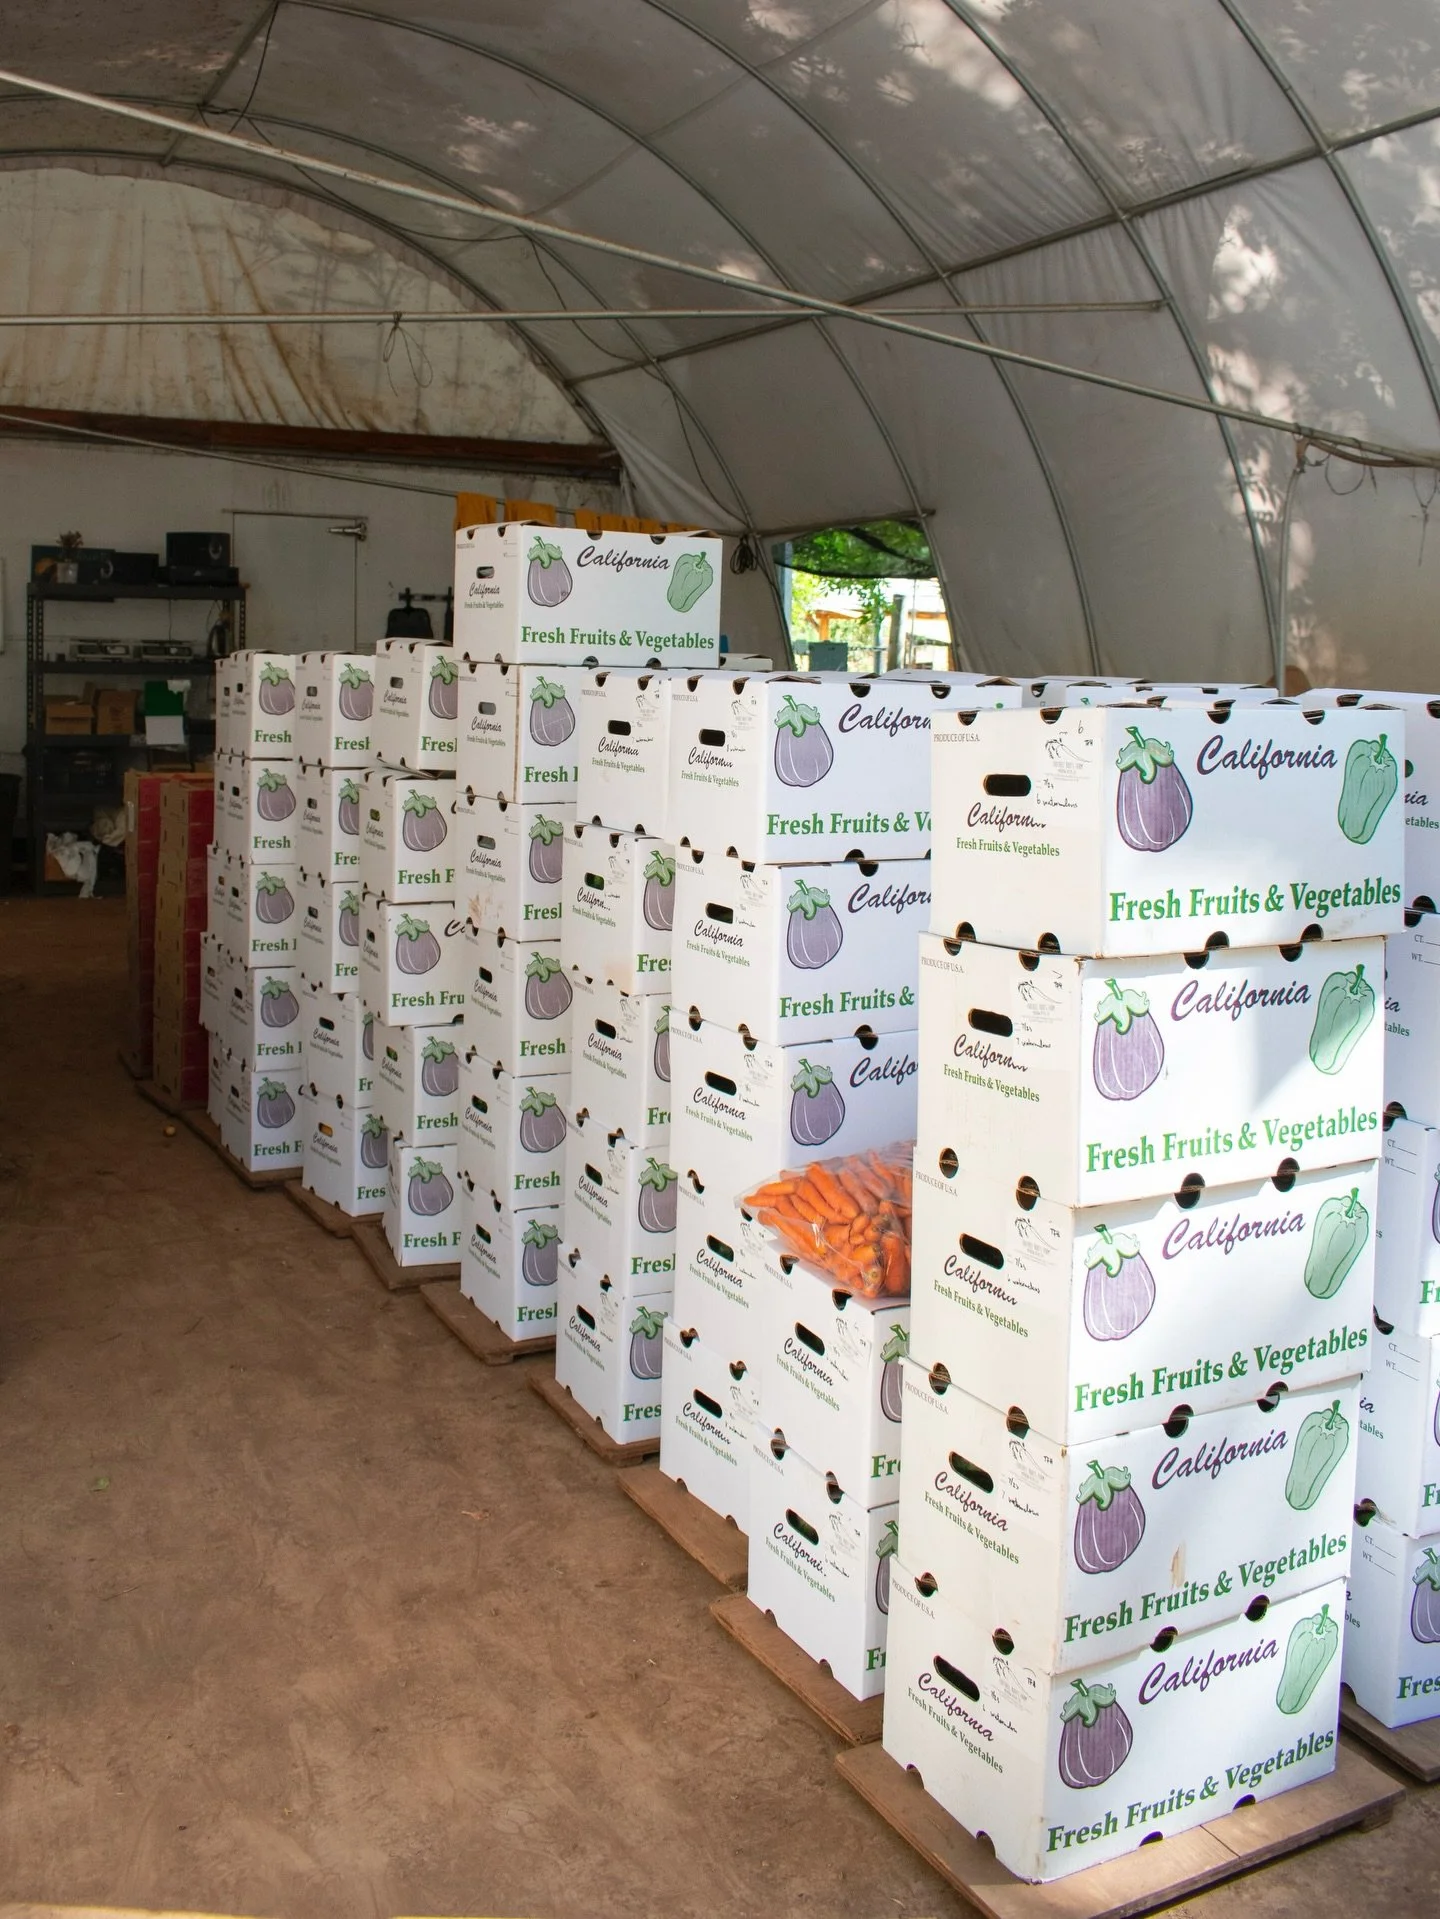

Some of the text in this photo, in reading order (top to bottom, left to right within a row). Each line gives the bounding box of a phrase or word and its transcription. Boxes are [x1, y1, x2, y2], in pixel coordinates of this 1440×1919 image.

[577, 545, 671, 573] California
[469, 582, 500, 598] California
[521, 626, 714, 653] Fresh Fruits & Vegetables
[838, 703, 931, 737] Californ
[254, 730, 292, 743] Fresh
[421, 736, 458, 753] Fres
[1197, 734, 1337, 780] California
[524, 766, 569, 783] Fresh
[766, 813, 824, 835] Fresh
[830, 811, 890, 834] Fruits
[893, 811, 910, 832] &
[967, 802, 1046, 833] Californ
[1405, 816, 1440, 829] etables
[253, 836, 291, 849] Fresh
[956, 837, 1060, 857] Fresh Fruits & Vegetables
[334, 852, 360, 866] Fre
[470, 849, 502, 868] California
[397, 869, 441, 884] Fresh
[847, 883, 931, 914] Califor
[1110, 876, 1401, 921] Fresh Fruits & Vegetables
[523, 902, 562, 921] Fres
[252, 938, 289, 952] Fresh
[694, 919, 744, 947] California
[335, 963, 358, 977] Fre
[636, 954, 672, 973] Fre
[392, 991, 465, 1008] Fresh Fru
[779, 985, 915, 1018] Fresh Fruits &
[1172, 980, 1312, 1021] California
[1384, 1021, 1410, 1037] tables
[257, 1042, 294, 1056] Fresh
[520, 1038, 566, 1057] Fresh
[954, 1033, 1028, 1072] Californ
[850, 1053, 919, 1088] Califo
[944, 1064, 1040, 1102] Fresh Fruits & Vegetables
[693, 1086, 747, 1120] California
[416, 1112, 458, 1130] Fresh
[253, 1141, 290, 1156] Fresh
[1086, 1106, 1378, 1172] Fresh Fruits & Vegetables
[514, 1171, 561, 1190] Fresh
[357, 1187, 386, 1200] Fres
[404, 1232, 448, 1248] Fresh
[1163, 1210, 1306, 1260] California
[630, 1253, 676, 1275] Fres
[696, 1248, 743, 1288] California
[516, 1302, 558, 1322] Fres
[934, 1280, 1029, 1338] Fresh Fruits & Vegetables
[784, 1337, 834, 1387] California
[1074, 1327, 1367, 1412] Fresh Fruits & Vegetables
[623, 1403, 662, 1422] Fres
[1359, 1420, 1384, 1440] tables
[1152, 1429, 1289, 1490] California
[934, 1471, 1008, 1532] California
[924, 1491, 1020, 1564] Fresh Fruits & Vegetables
[1064, 1532, 1348, 1644] Fresh Fruits & Vegetables
[1138, 1637, 1280, 1706] California
[1396, 1675, 1440, 1699] Fres
[918, 1672, 994, 1742] California
[908, 1687, 1004, 1774] Fresh Fruits & Vegetables
[1046, 1726, 1334, 1853] Fresh Fruits & Vegetables
